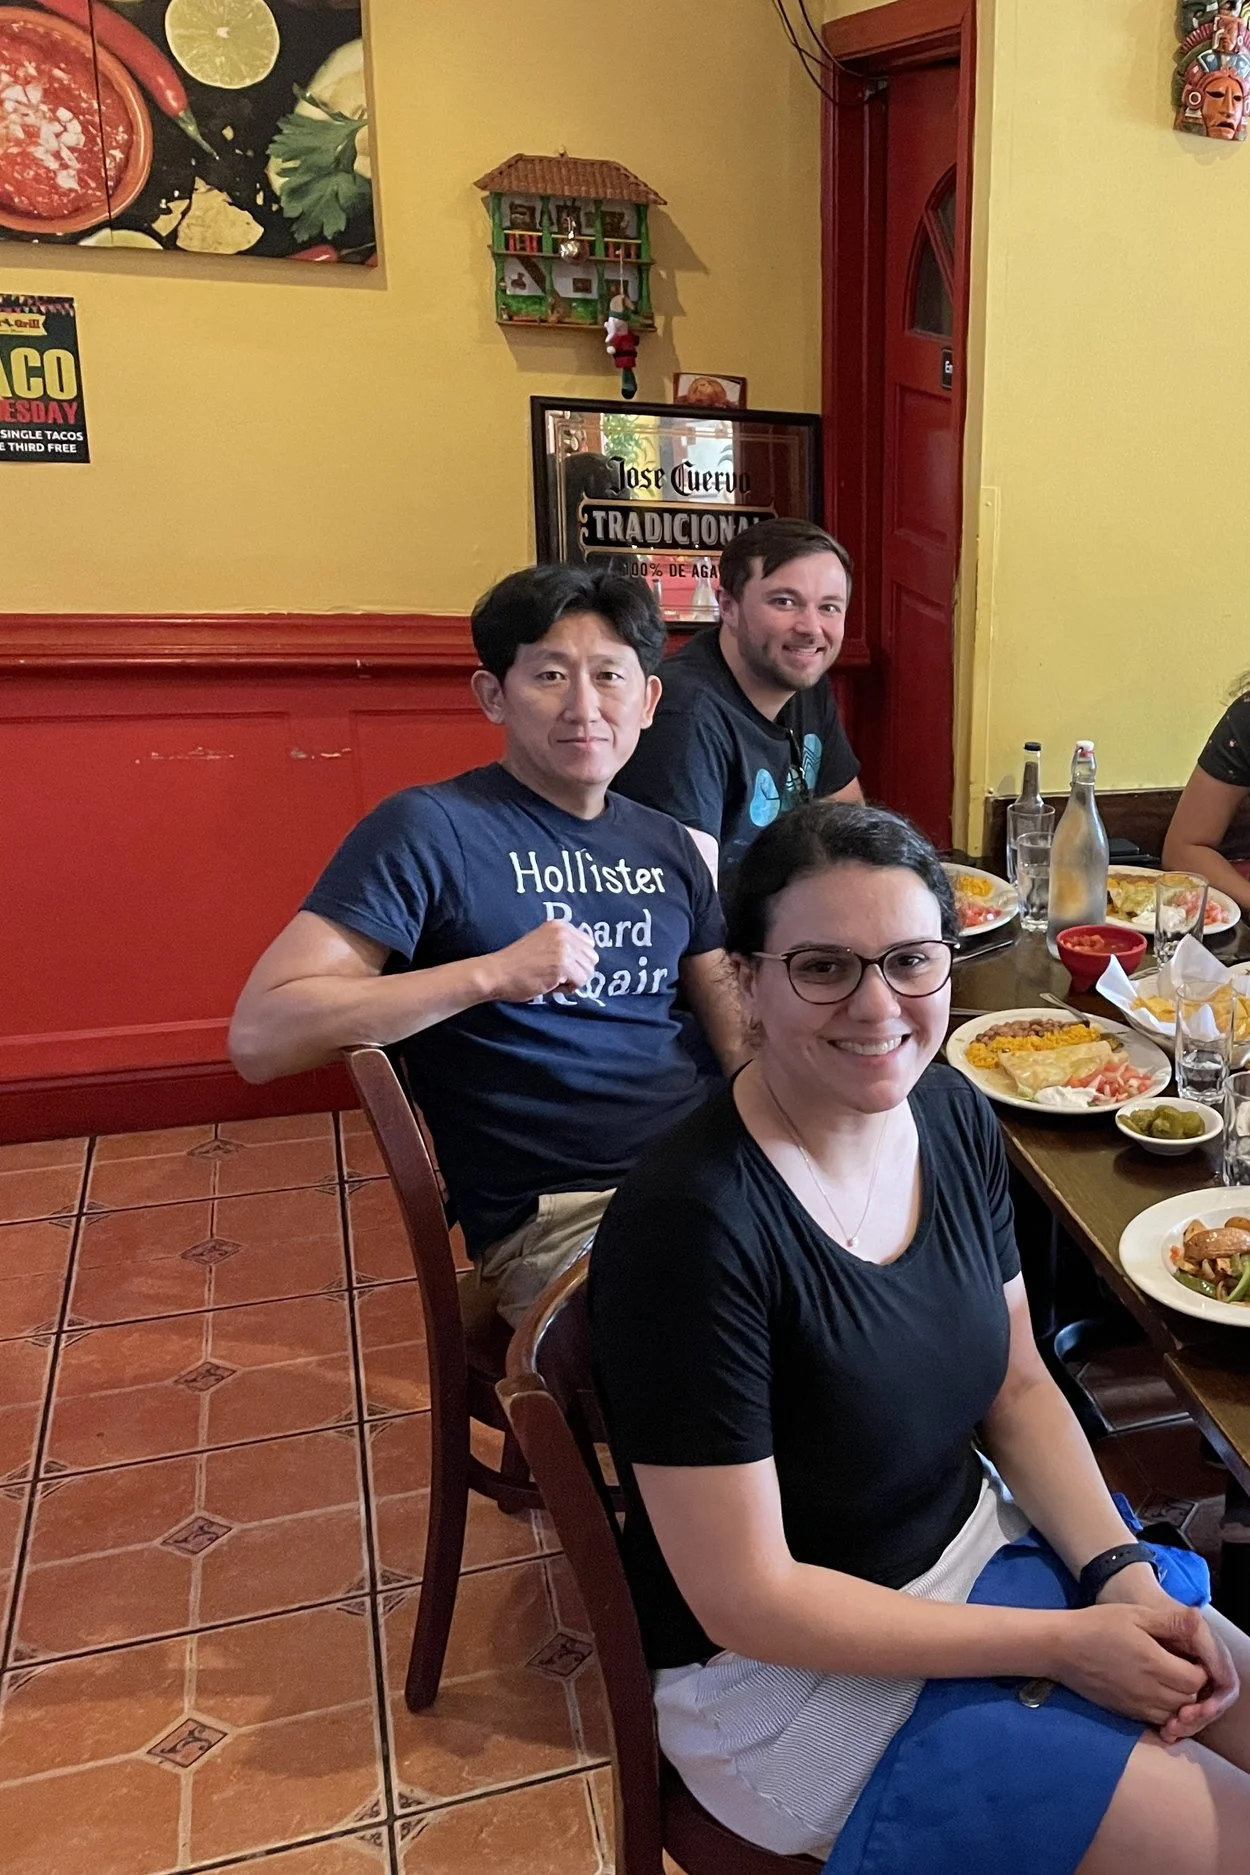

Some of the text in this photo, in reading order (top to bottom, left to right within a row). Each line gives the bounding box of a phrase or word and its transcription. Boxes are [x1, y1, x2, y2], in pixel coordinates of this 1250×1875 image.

[14, 319, 40, 329] Grill
[0, 347, 78, 400] CO
[0, 400, 78, 425] ESDAY
[0, 430, 84, 441] SINGLE TACOS
[9, 442, 45, 453] THIRD
[47, 443, 77, 454] FREE
[606, 456, 750, 497] Jose Cuervo
[592, 510, 760, 546] TRADICIONA
[624, 562, 722, 579] 100% DE AGA
[509, 848, 665, 894] Hollister
[527, 956, 668, 1007] pair
